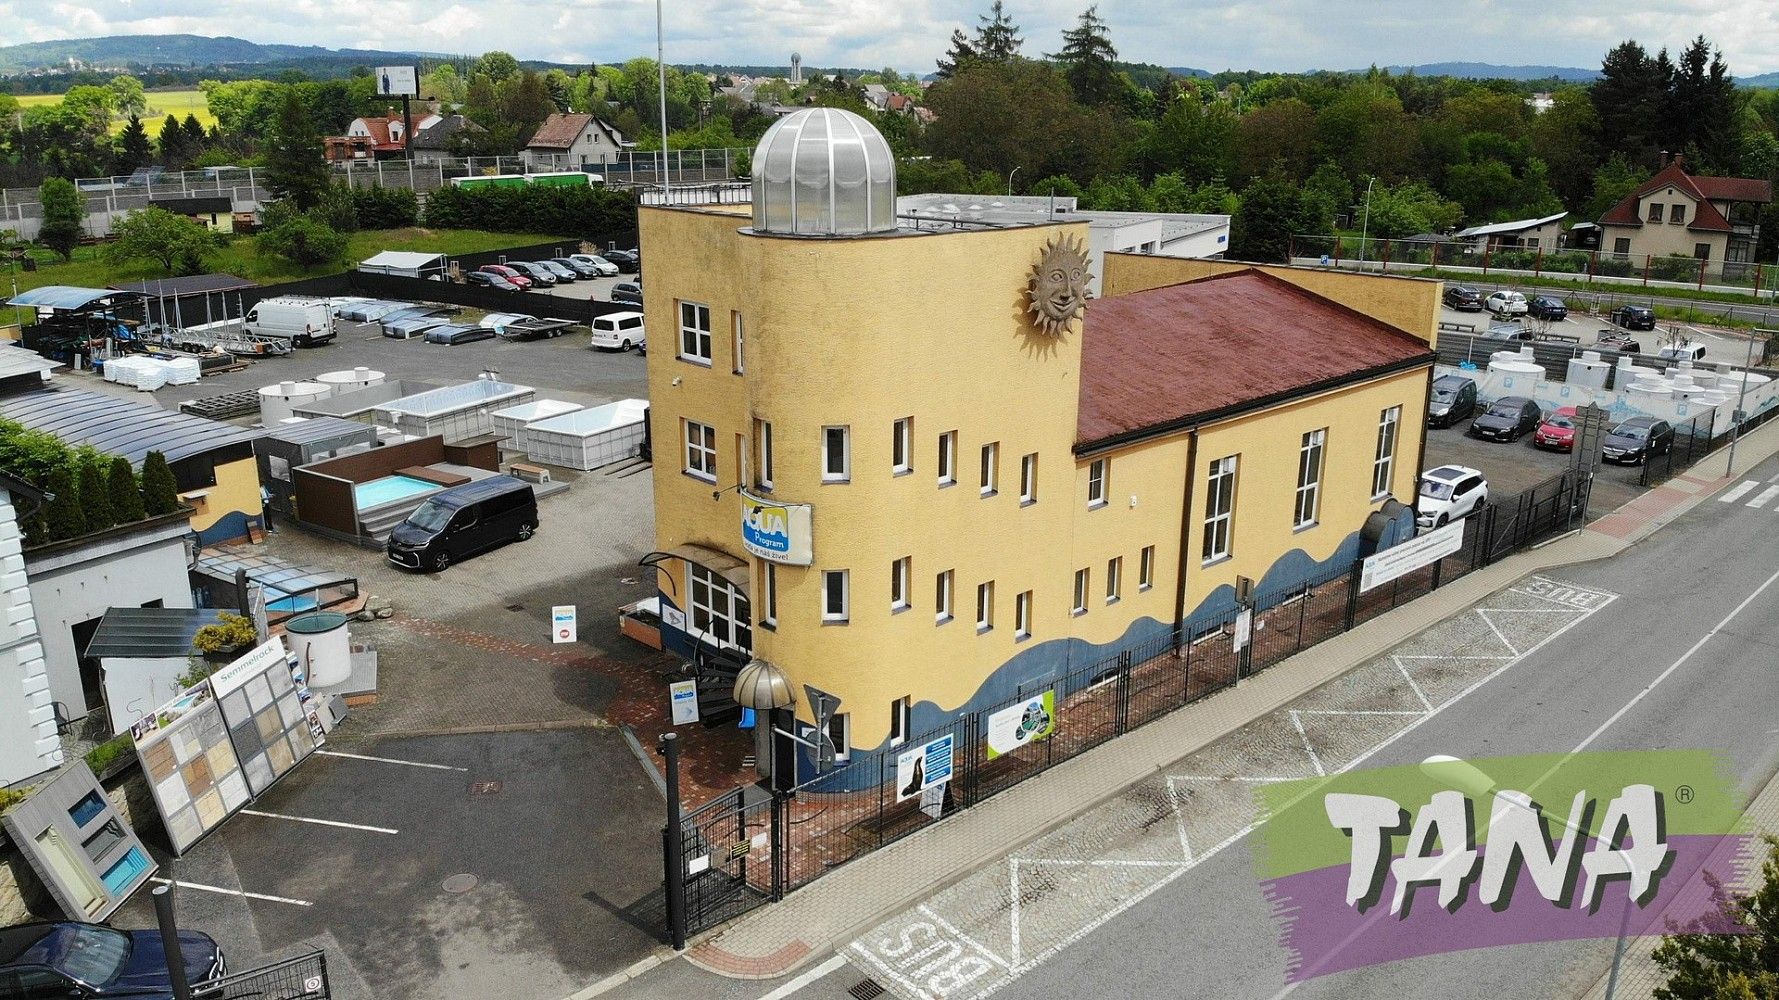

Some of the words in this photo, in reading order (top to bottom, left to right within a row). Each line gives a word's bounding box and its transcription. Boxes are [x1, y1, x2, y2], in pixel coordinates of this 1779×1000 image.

[755, 532, 784, 549] Program
[220, 644, 274, 682] Semmelrock
[879, 922, 992, 997] BUS
